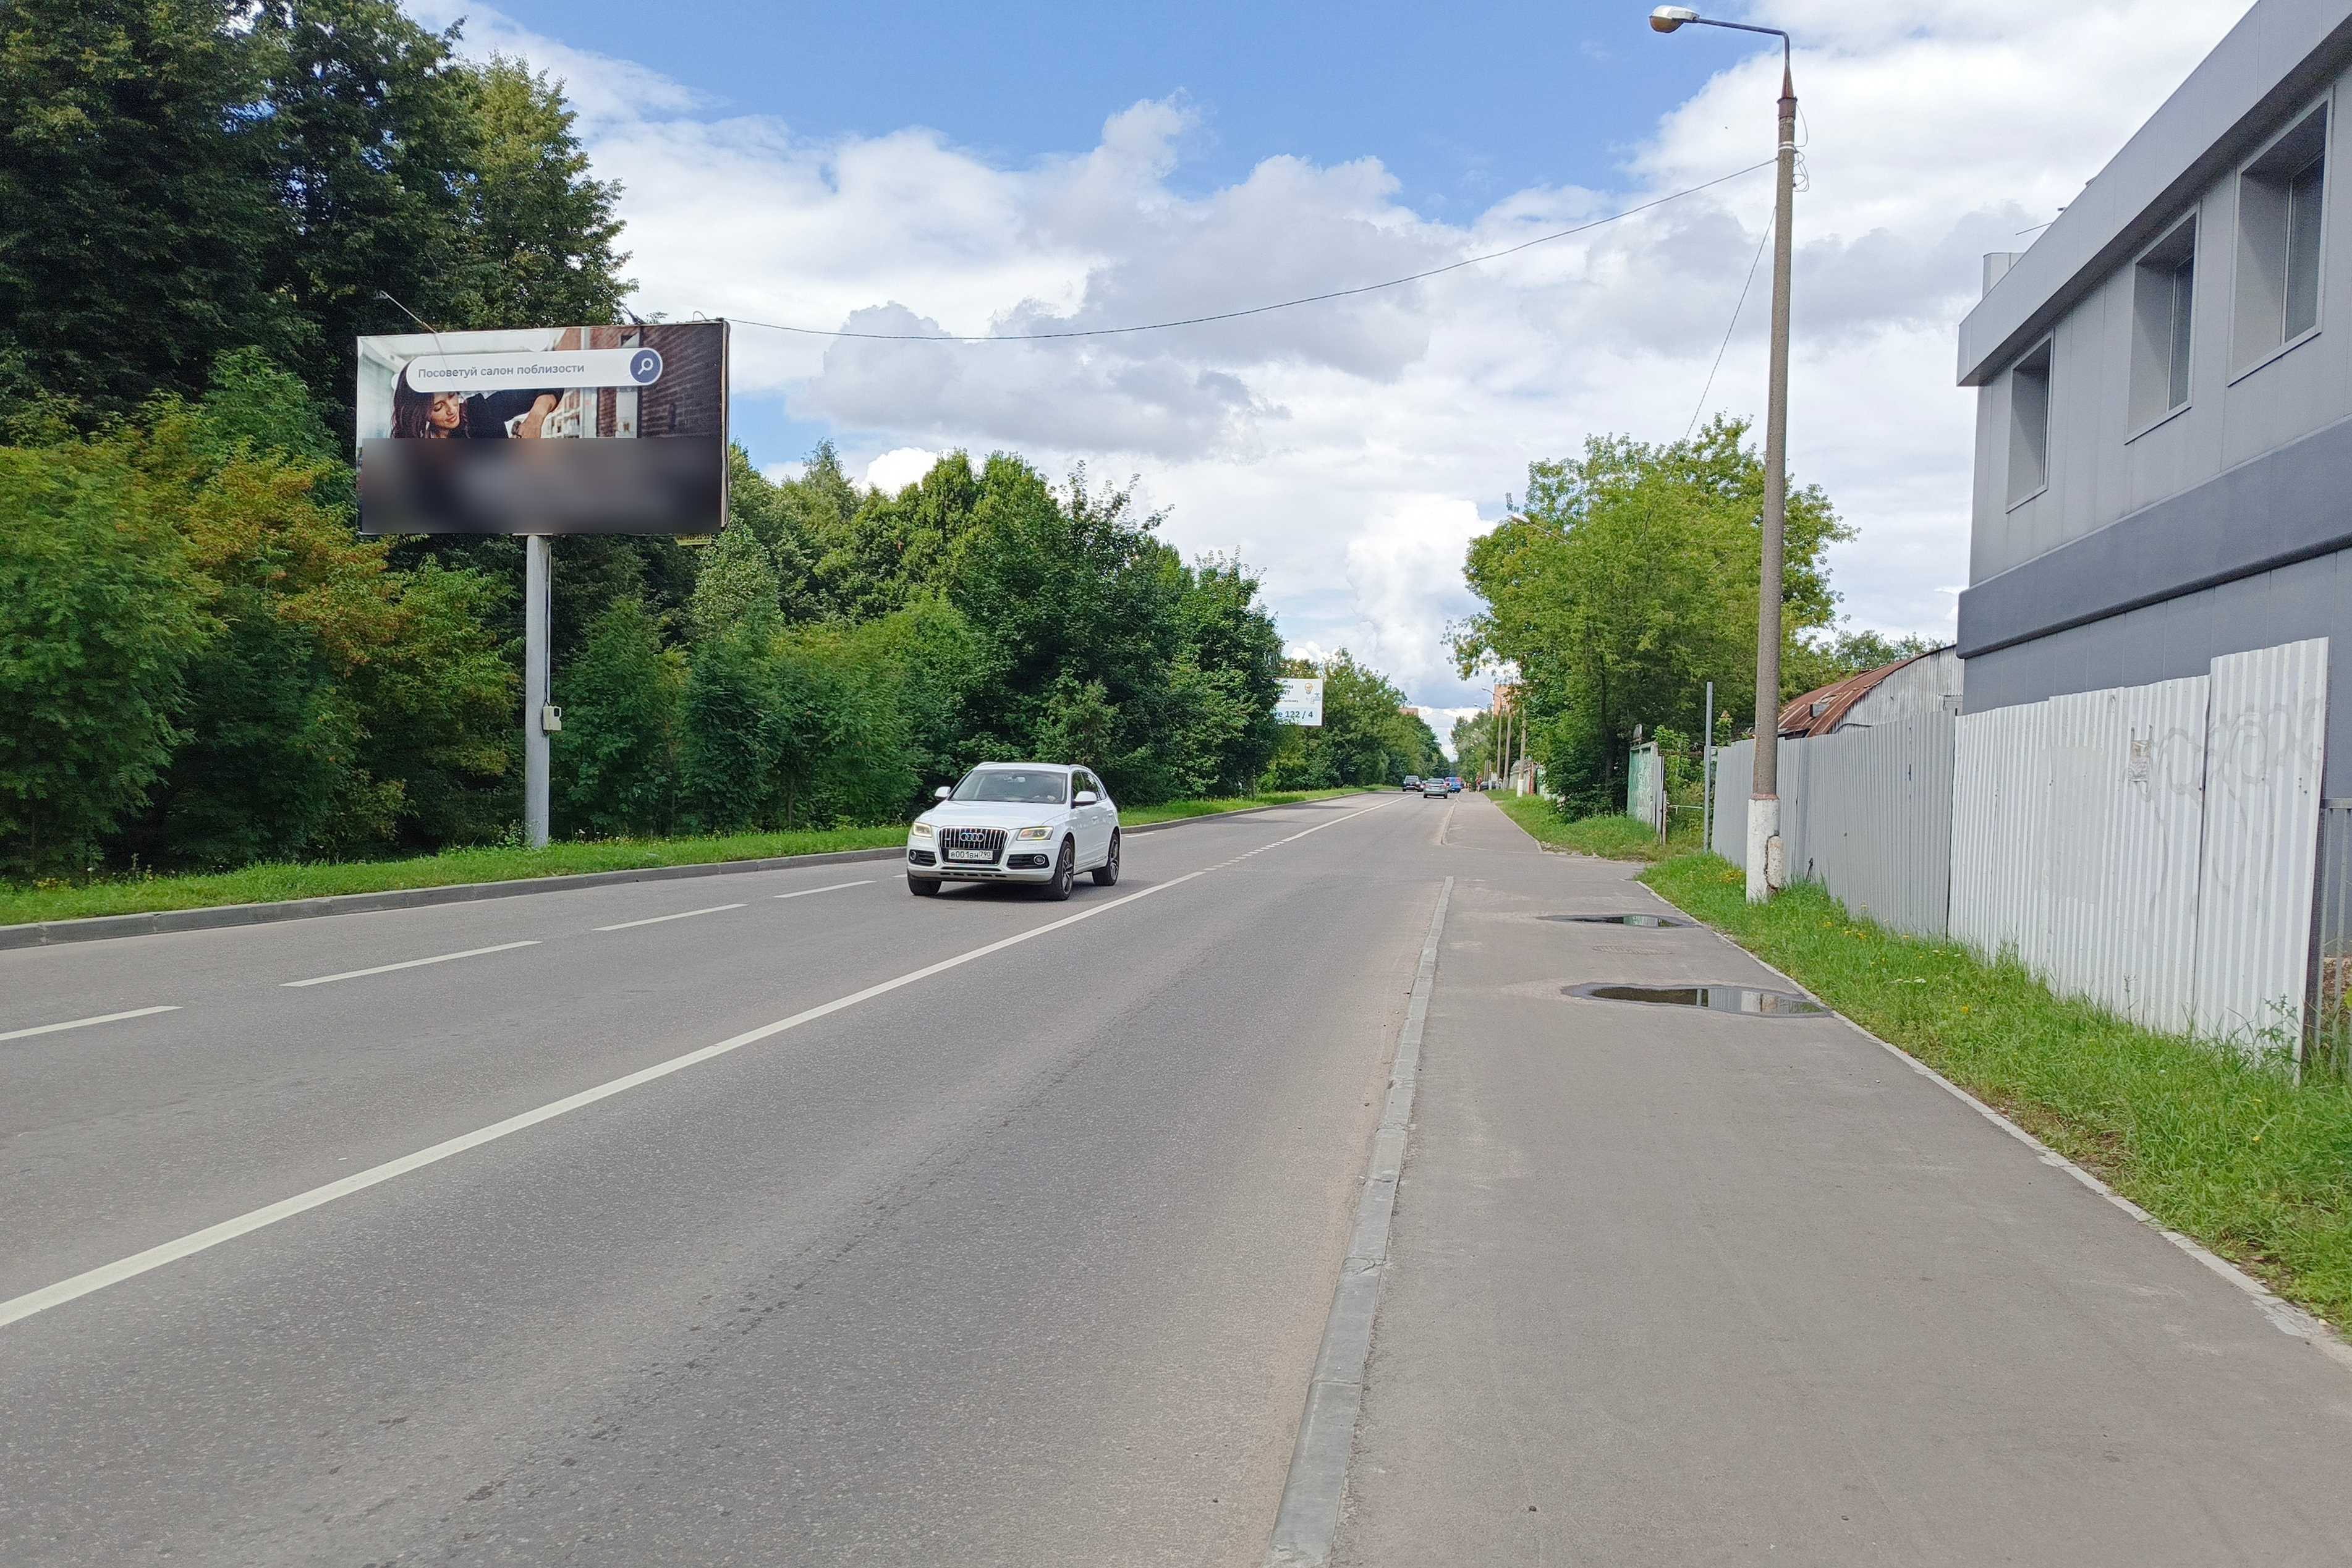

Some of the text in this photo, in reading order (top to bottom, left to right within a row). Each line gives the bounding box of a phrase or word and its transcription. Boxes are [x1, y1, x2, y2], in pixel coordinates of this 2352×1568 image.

[418, 364, 585, 379] Посоветуй салон поблизости
